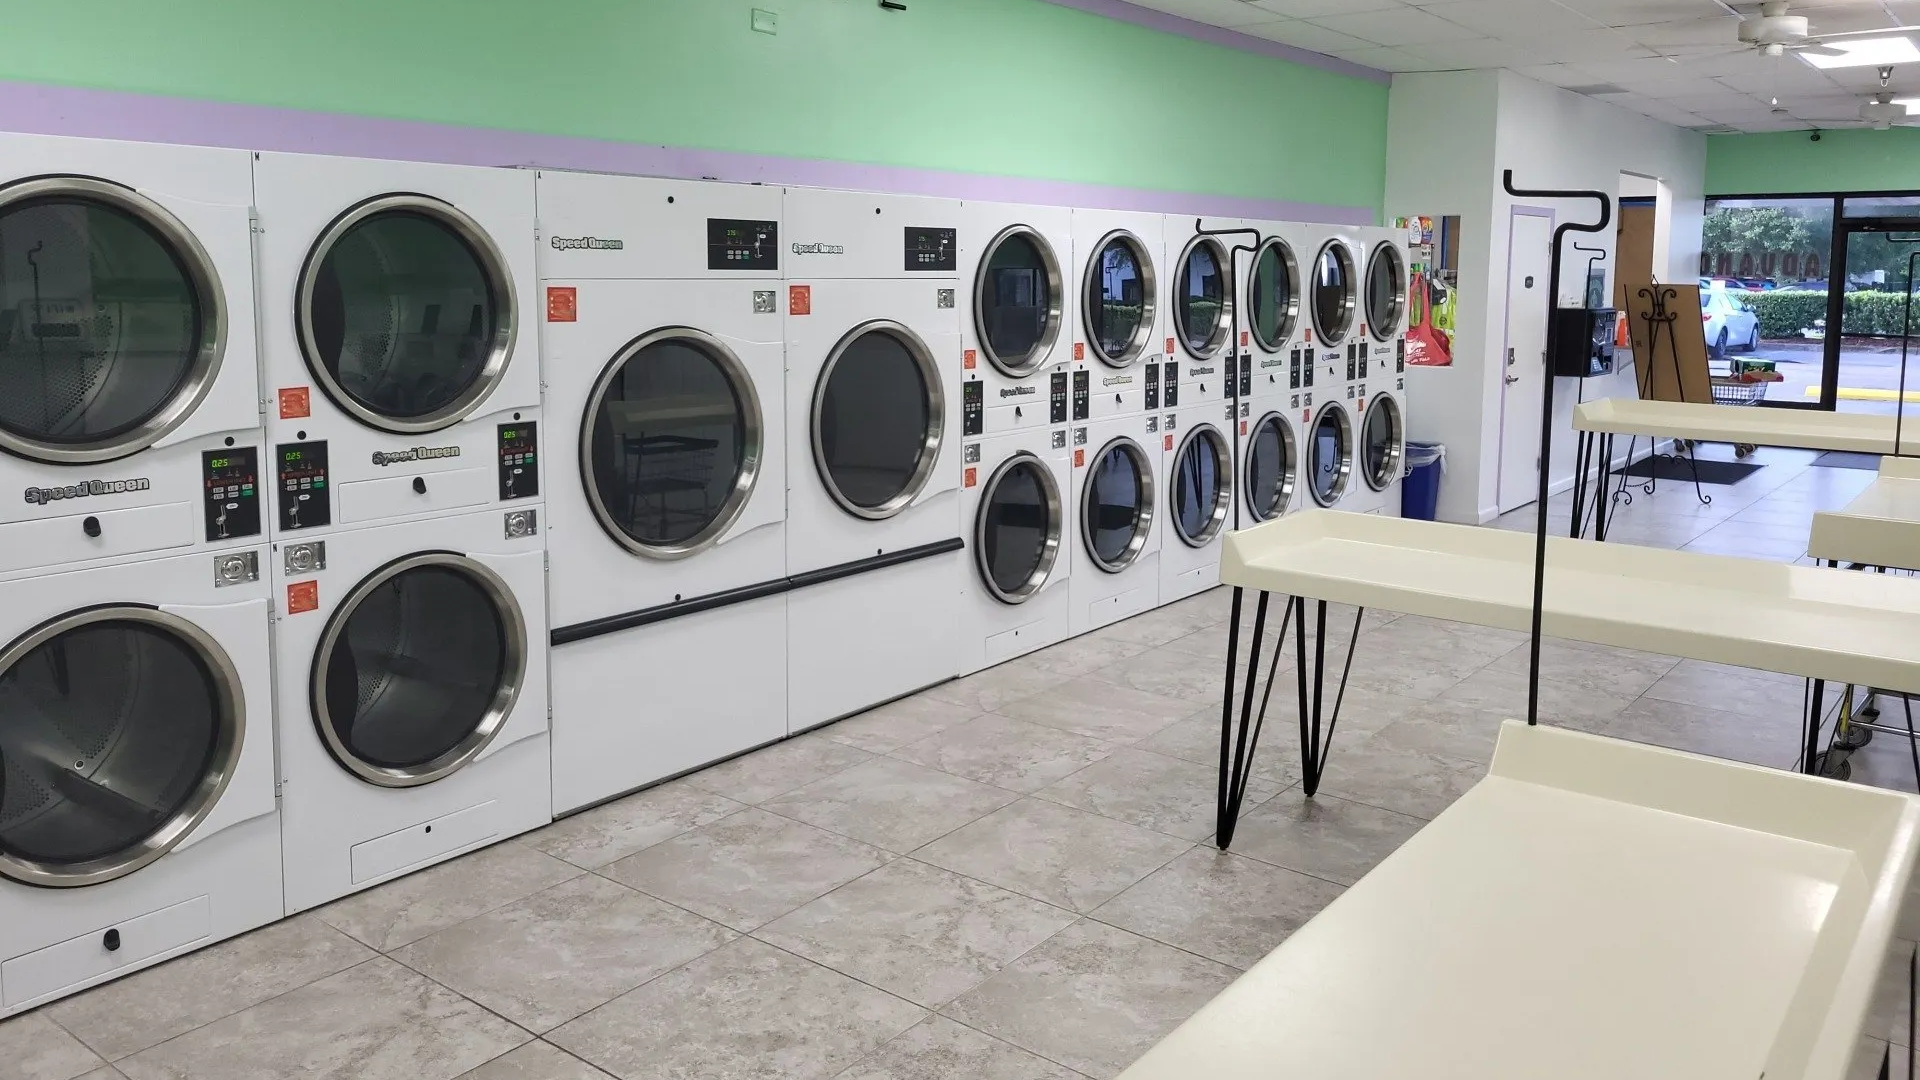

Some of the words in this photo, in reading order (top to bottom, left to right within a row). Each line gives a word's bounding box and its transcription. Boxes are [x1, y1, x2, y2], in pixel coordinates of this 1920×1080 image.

[552, 236, 588, 251] Speed
[588, 236, 623, 250] Queen
[792, 242, 819, 255] Speed
[818, 242, 844, 254] Queen
[372, 447, 417, 466] Speed
[417, 446, 460, 460] Queen
[25, 481, 89, 505] Speed
[89, 477, 150, 495] Queen
